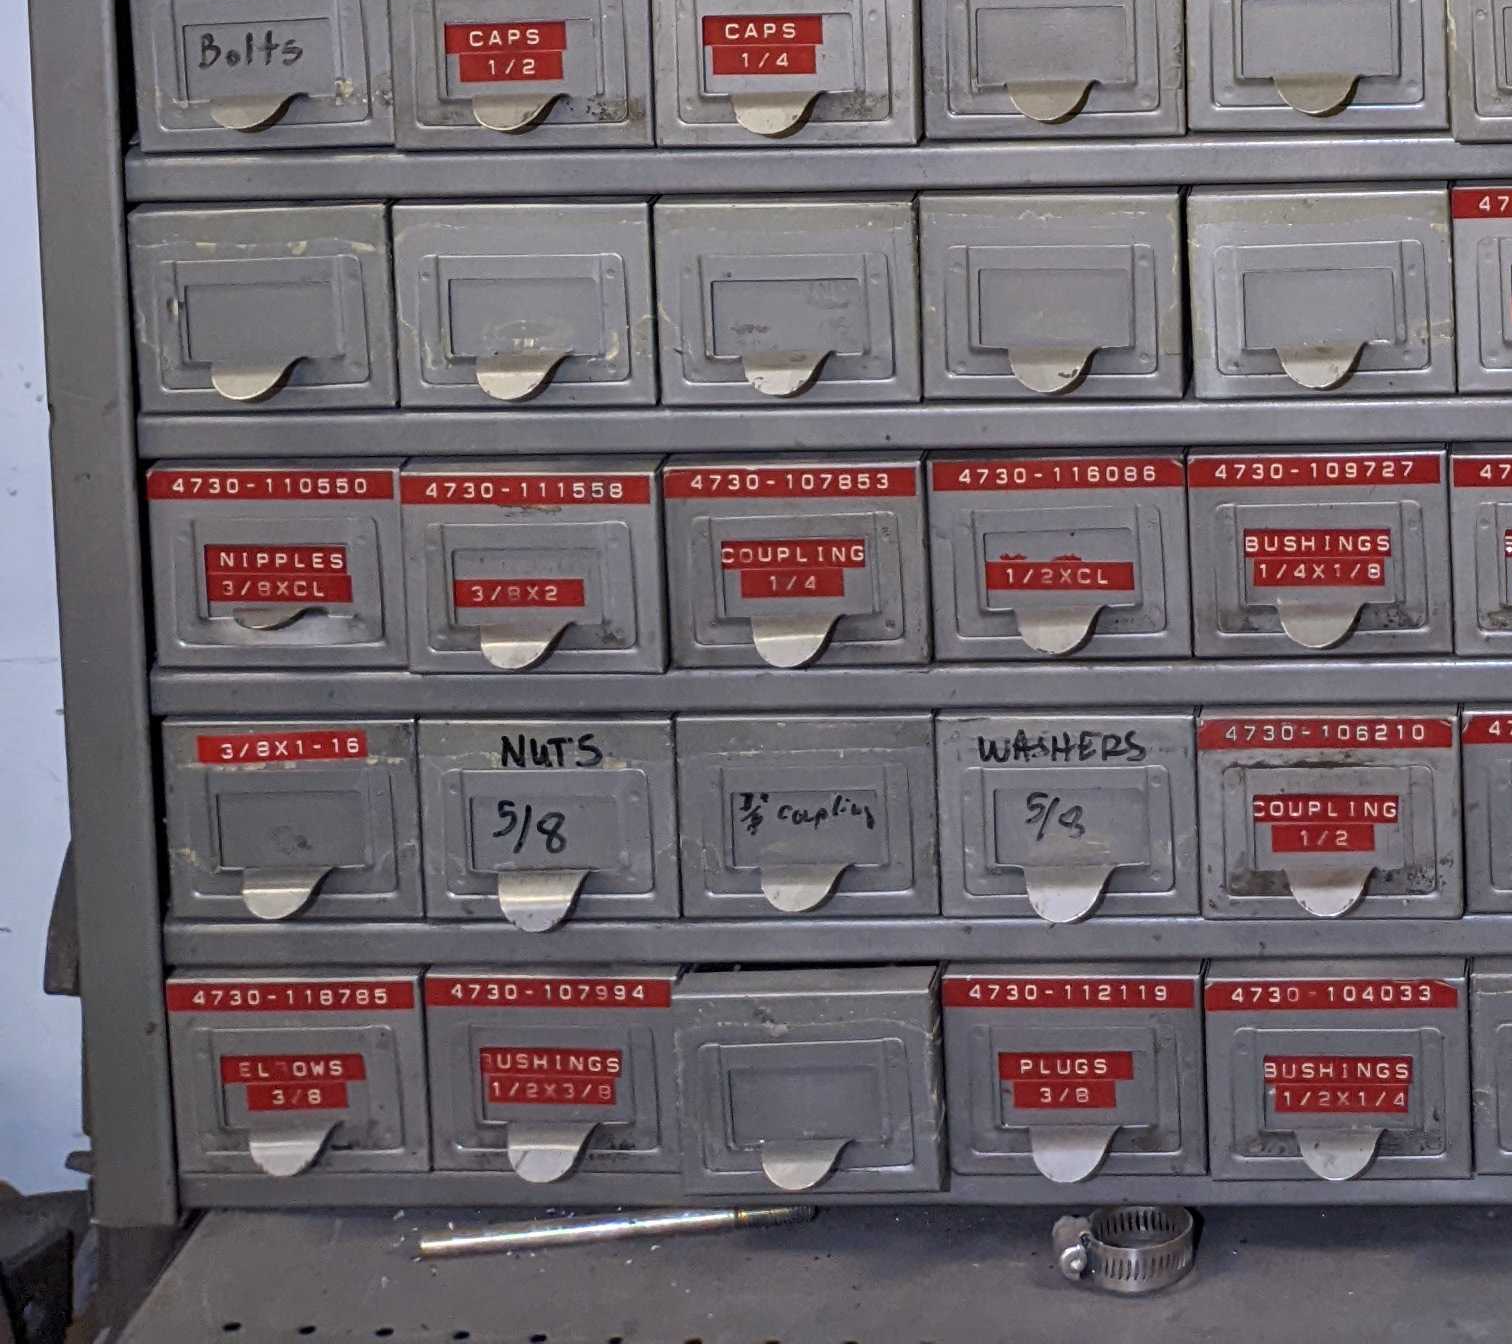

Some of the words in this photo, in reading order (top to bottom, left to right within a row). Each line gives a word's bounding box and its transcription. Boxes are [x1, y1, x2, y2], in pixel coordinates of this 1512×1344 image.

[469, 30, 541, 46] CAPS
[724, 22, 796, 39] CAPS
[199, 31, 303, 68] Bolts
[488, 59, 536, 75] 1/2
[742, 53, 789, 68] 1/4
[959, 466, 1157, 483] 4730-116086
[1215, 461, 1413, 479] 4730-109727
[172, 478, 366, 495] 4730-110550
[691, 473, 890, 490] 4730-107853
[427, 482, 622, 499] 4730-111558
[1246, 535, 1390, 551] BUSHINGS
[220, 552, 344, 568] NIPPLES
[722, 545, 865, 562] COUPLING
[1006, 568, 1108, 584] 1/2XCL
[1259, 564, 1380, 580] 1/4X1/8
[222, 580, 324, 597] 3/8XCL
[769, 576, 817, 592] 1/4
[472, 586, 557, 601] 3/8X2
[1225, 724, 1424, 741] 4730-106210
[220, 738, 359, 759] 3/8X1-16
[978, 731, 1146, 763] WASHERS
[1254, 800, 1396, 818] COUPLING
[1300, 830, 1347, 846] 1/2
[192, 988, 388, 1006] 4730-118785
[451, 984, 644, 1001] 4730-107994
[969, 984, 1168, 1000] 4730-112119
[1231, 985, 1431, 1003] 4730-104033
[1020, 1058, 1108, 1075] PLUGS
[1264, 1062, 1409, 1080] BUSHINGS
[272, 1089, 322, 1104] 3/8
[491, 1081, 611, 1100] 1/2X3/8
[1040, 1087, 1089, 1104] 3/8
[1284, 1091, 1405, 1108] 1/2X1/4
